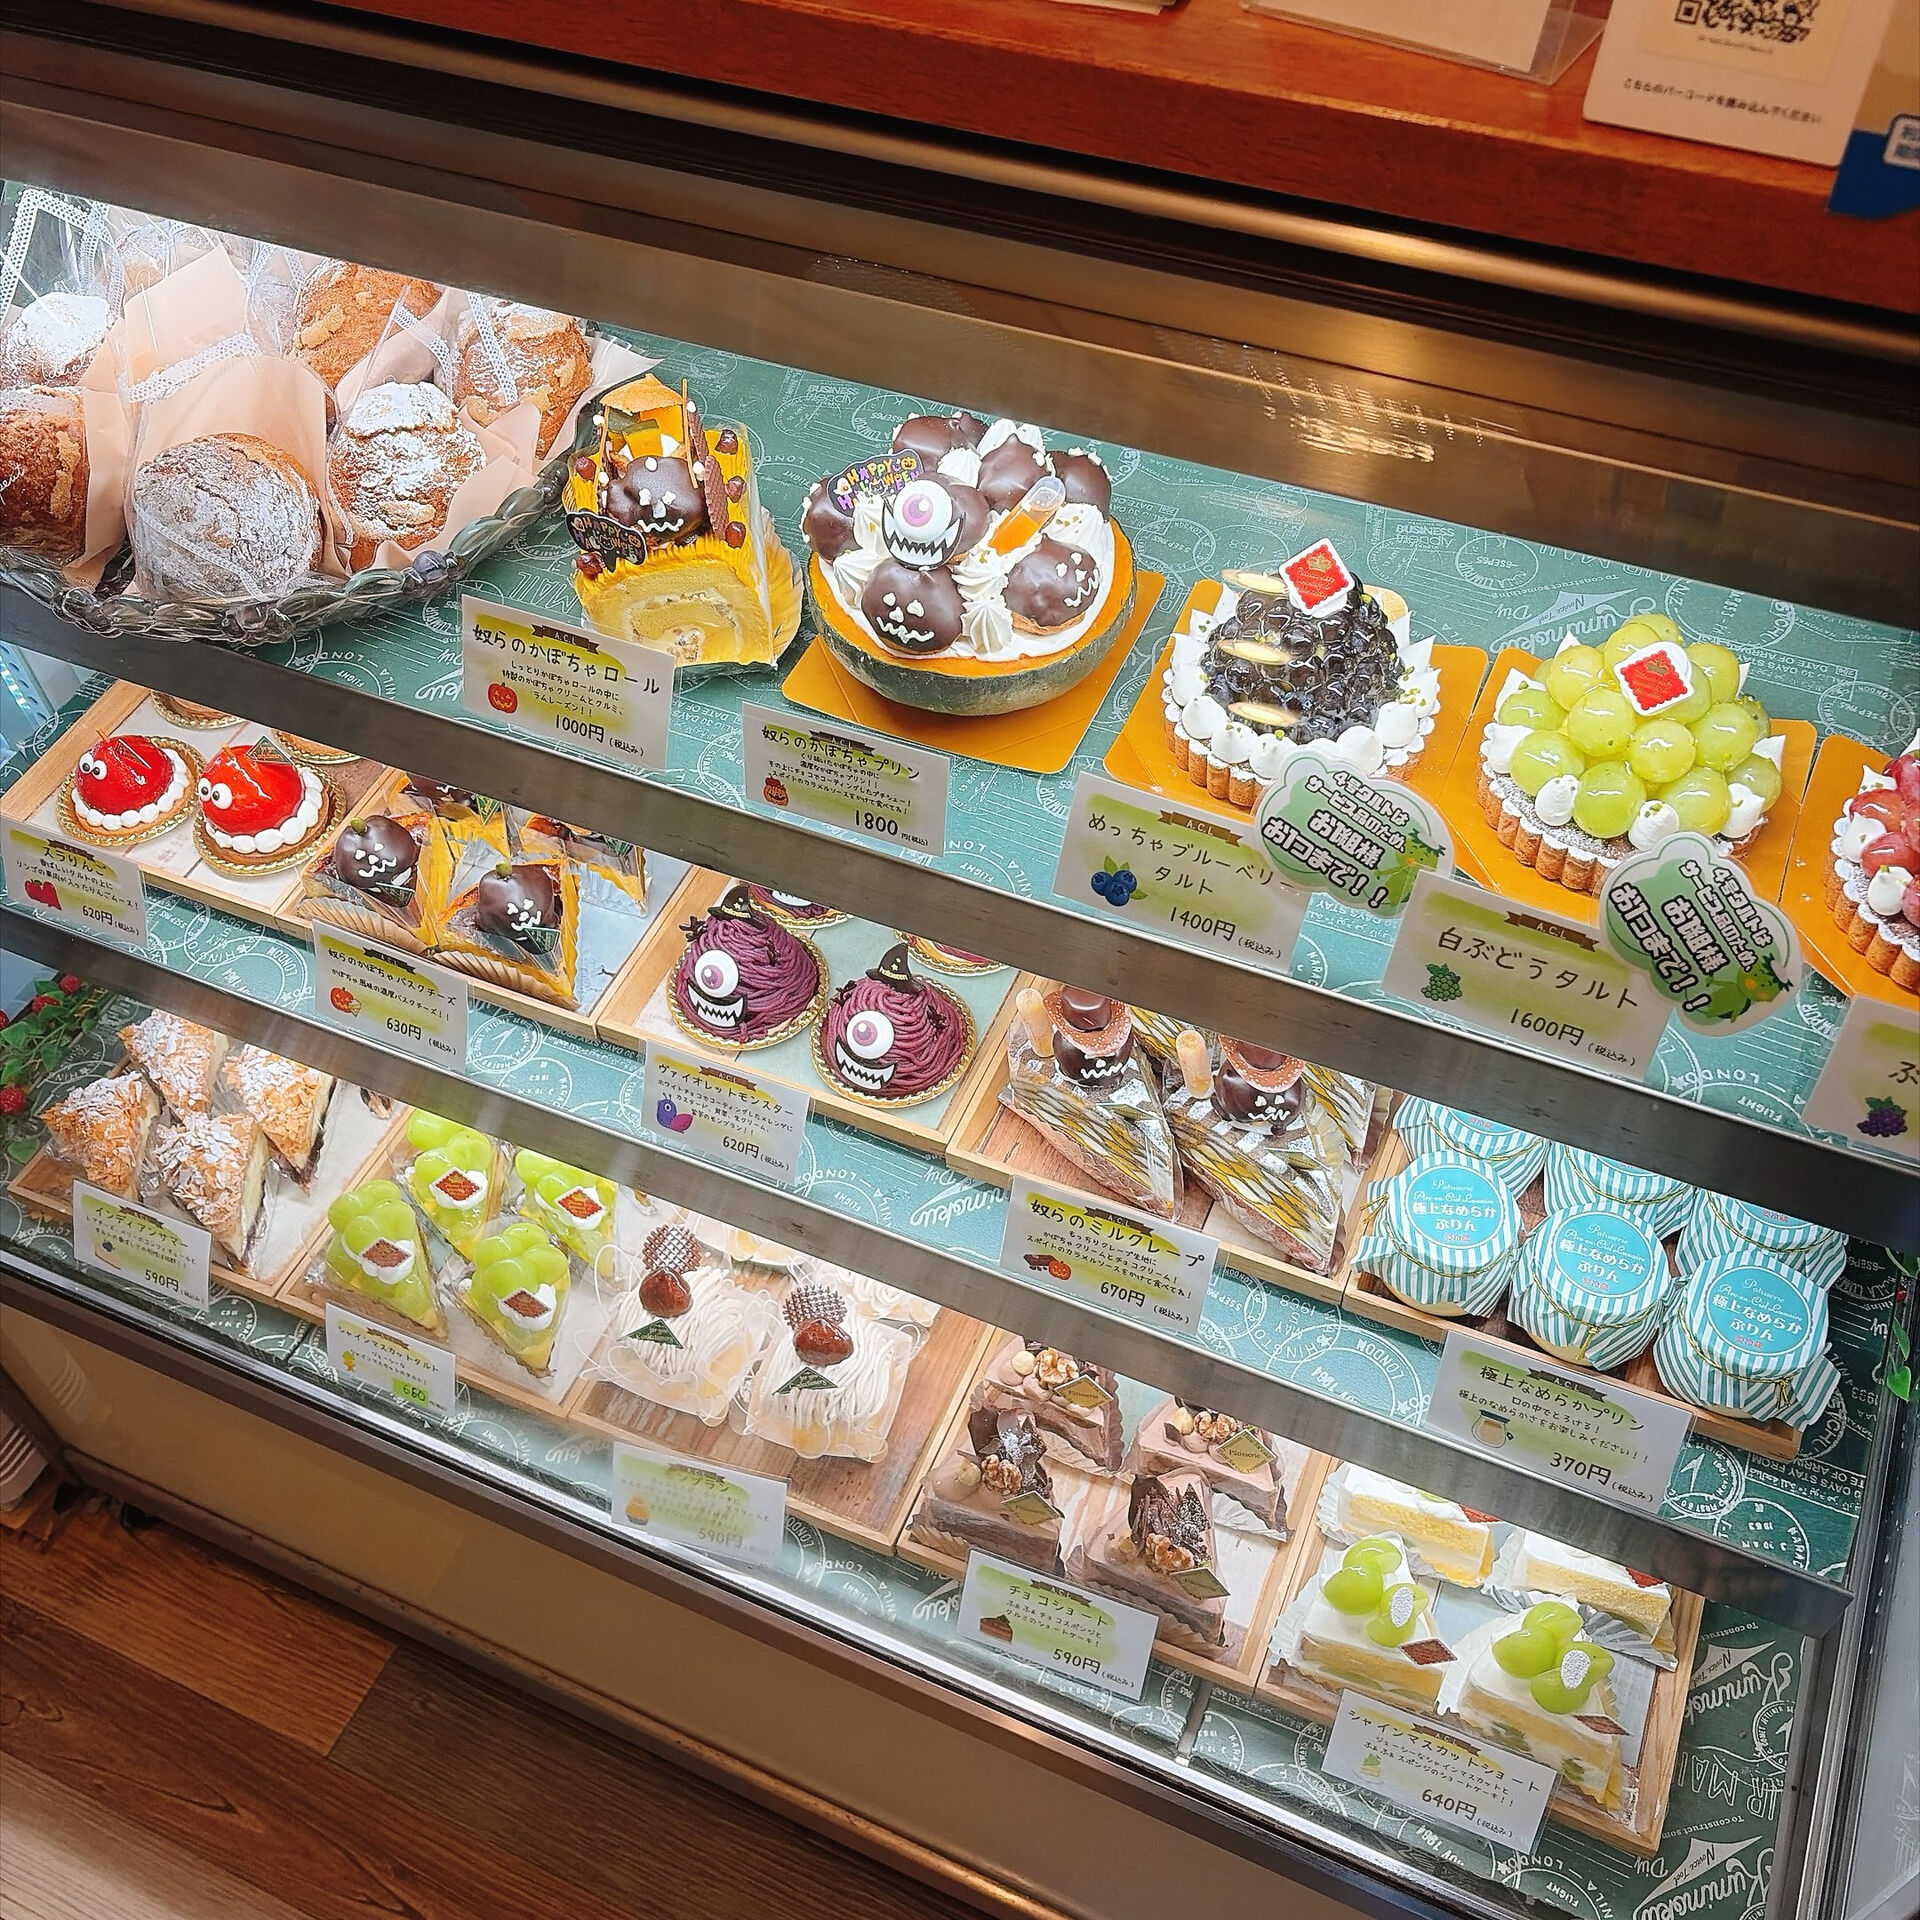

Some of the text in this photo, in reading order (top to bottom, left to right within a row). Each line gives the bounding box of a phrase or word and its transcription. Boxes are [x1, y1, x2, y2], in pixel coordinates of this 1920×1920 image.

[846, 458, 893, 486] HAPPY
[473, 624, 660, 695] 奴らのかぼちゃロール
[1779, 656, 1828, 673] DATE OF
[555, 715, 604, 744] 1000円
[761, 726, 920, 780] 奴らのかぼちゃプリン
[855, 810, 898, 836] 1800
[1186, 820, 1214, 835] A.C.L
[43, 846, 106, 876] スラりんご
[1088, 813, 1295, 889] めっちゃブルーベリー
[1154, 866, 1214, 895] タルト
[83, 905, 113, 927] 620円
[1170, 906, 1237, 942] 1400円
[1536, 922, 1567, 939] A.C.L
[328, 948, 457, 1006] 奴らのかぼちゃバスクチーズ
[1437, 927, 1639, 1010] 白ぶどうタルト
[386, 1017, 422, 1041] 630円
[1510, 1008, 1585, 1047] 1600円
[658, 1064, 794, 1116] ヴァイオレットモンスター
[722, 1136, 760, 1160] 620円
[1412, 1201, 1497, 1219] 極上なめらか
[1031, 1199, 1205, 1268] 奴らのミルクレープ
[1559, 1238, 1645, 1276] 極上なめらか
[144, 1269, 179, 1292] 590円
[1100, 1281, 1146, 1308] 670円
[1712, 1293, 1802, 1335] 極上なめらか
[1479, 1365, 1645, 1432] 極上なめらかプリン
[1512, 1396, 1601, 1434] 口の中でとろける！
[1550, 1451, 1653, 1503] 370円 （税込み）
[1788, 1468, 1818, 1485] STAY
[1820, 1478, 1852, 1496] DAYS
[1009, 1585, 1109, 1627] チョコショート
[1052, 1648, 1101, 1675] 590円
[1348, 1710, 1540, 1793] シャインマスカットショート
[1422, 1789, 1478, 1822] 640円
